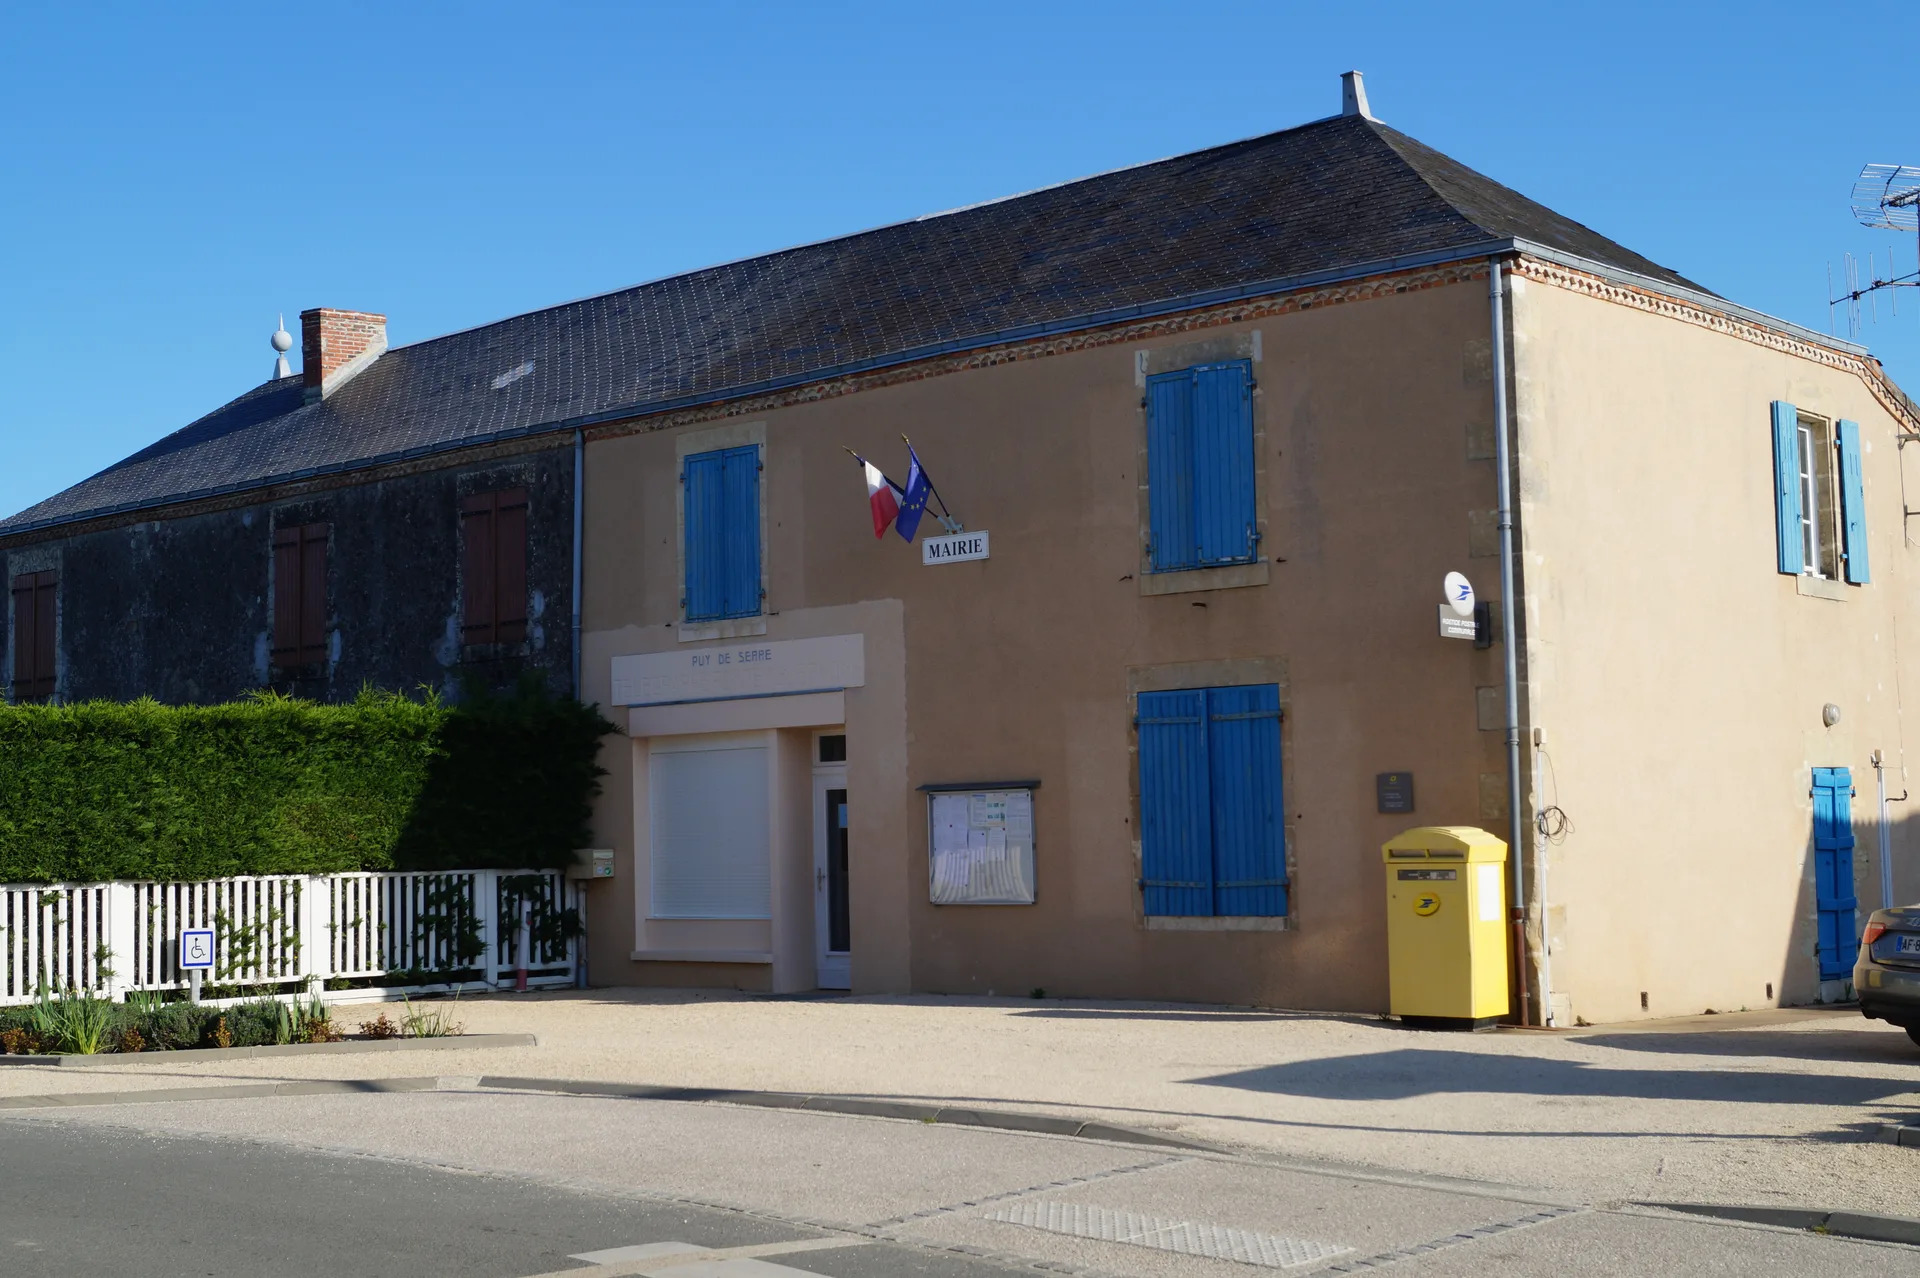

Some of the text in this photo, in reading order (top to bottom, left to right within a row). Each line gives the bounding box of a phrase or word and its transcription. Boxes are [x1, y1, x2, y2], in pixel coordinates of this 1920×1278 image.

[929, 538, 983, 558] MAIRIE
[692, 649, 772, 667] PUY DE SERRE
